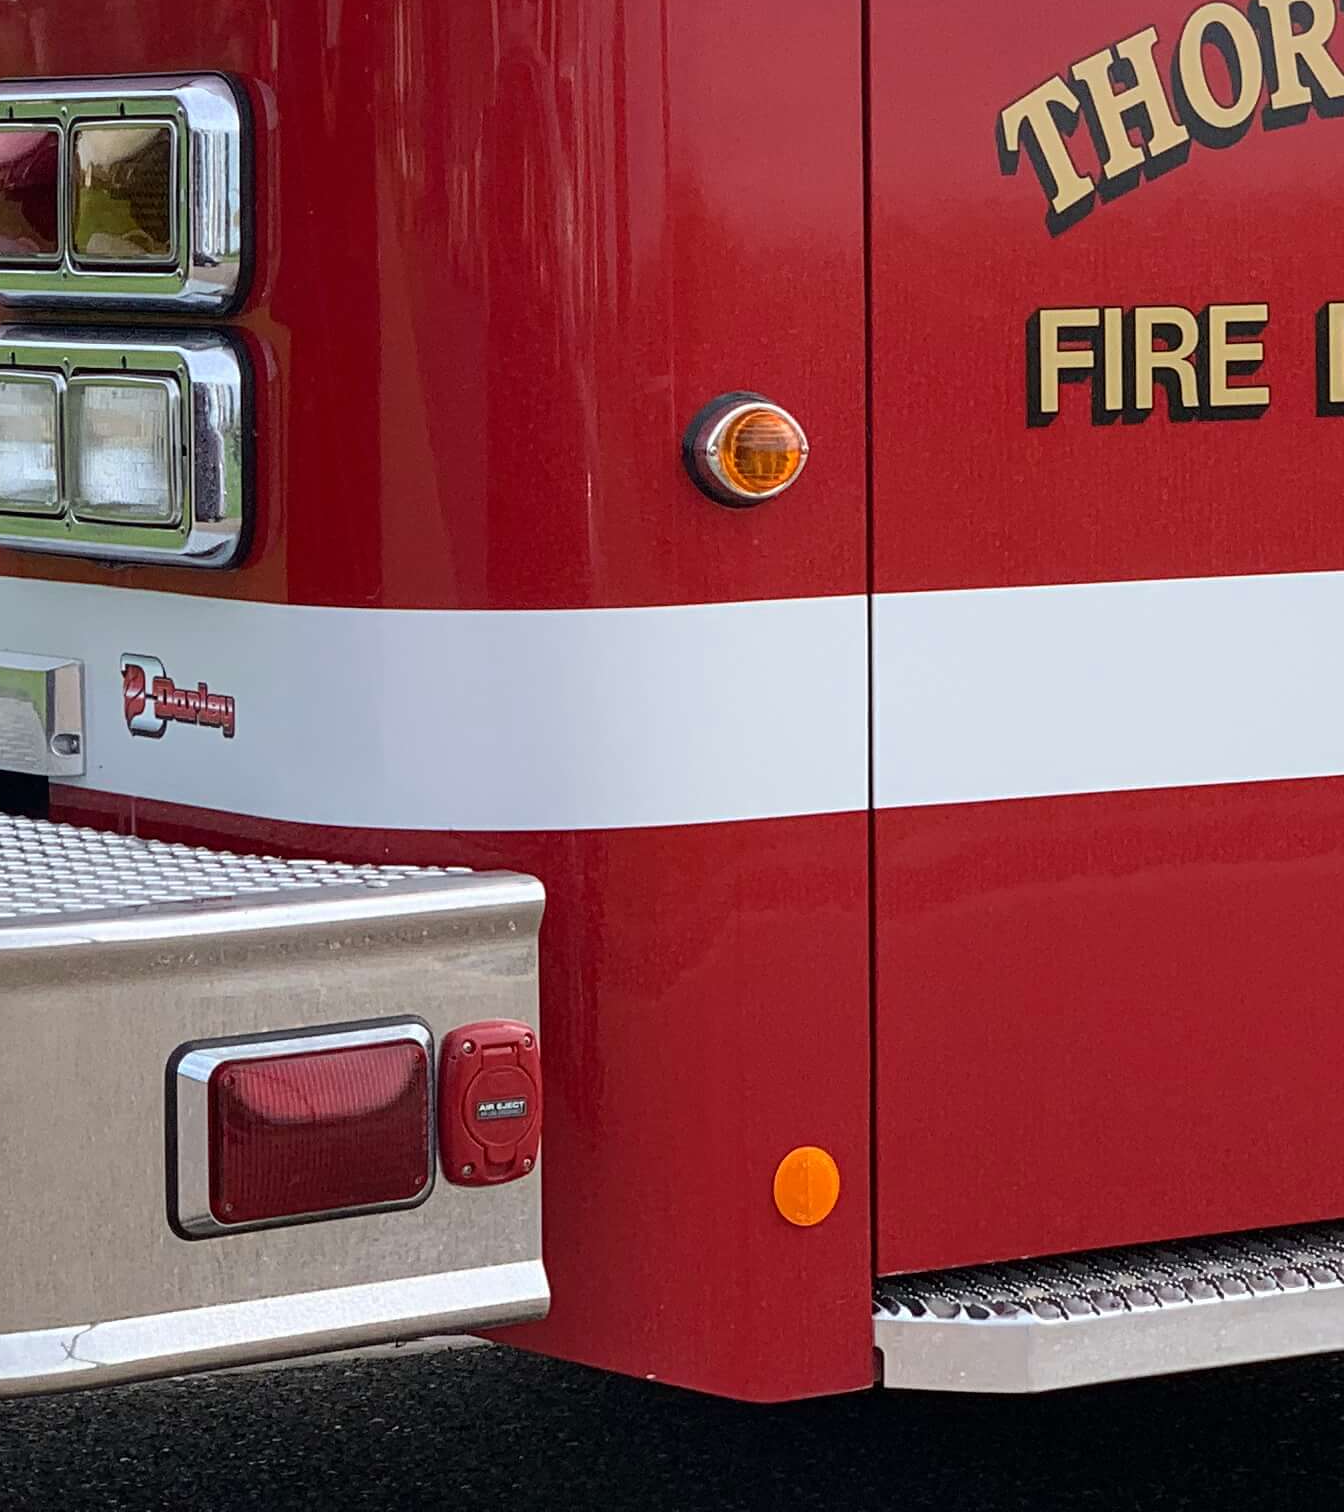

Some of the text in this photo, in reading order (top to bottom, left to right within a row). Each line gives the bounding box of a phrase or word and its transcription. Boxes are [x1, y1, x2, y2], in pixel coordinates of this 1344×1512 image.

[1027, 304, 1270, 427] FIRE
[153, 676, 235, 738] Darley
[479, 1100, 524, 1113] AIR EJECT
